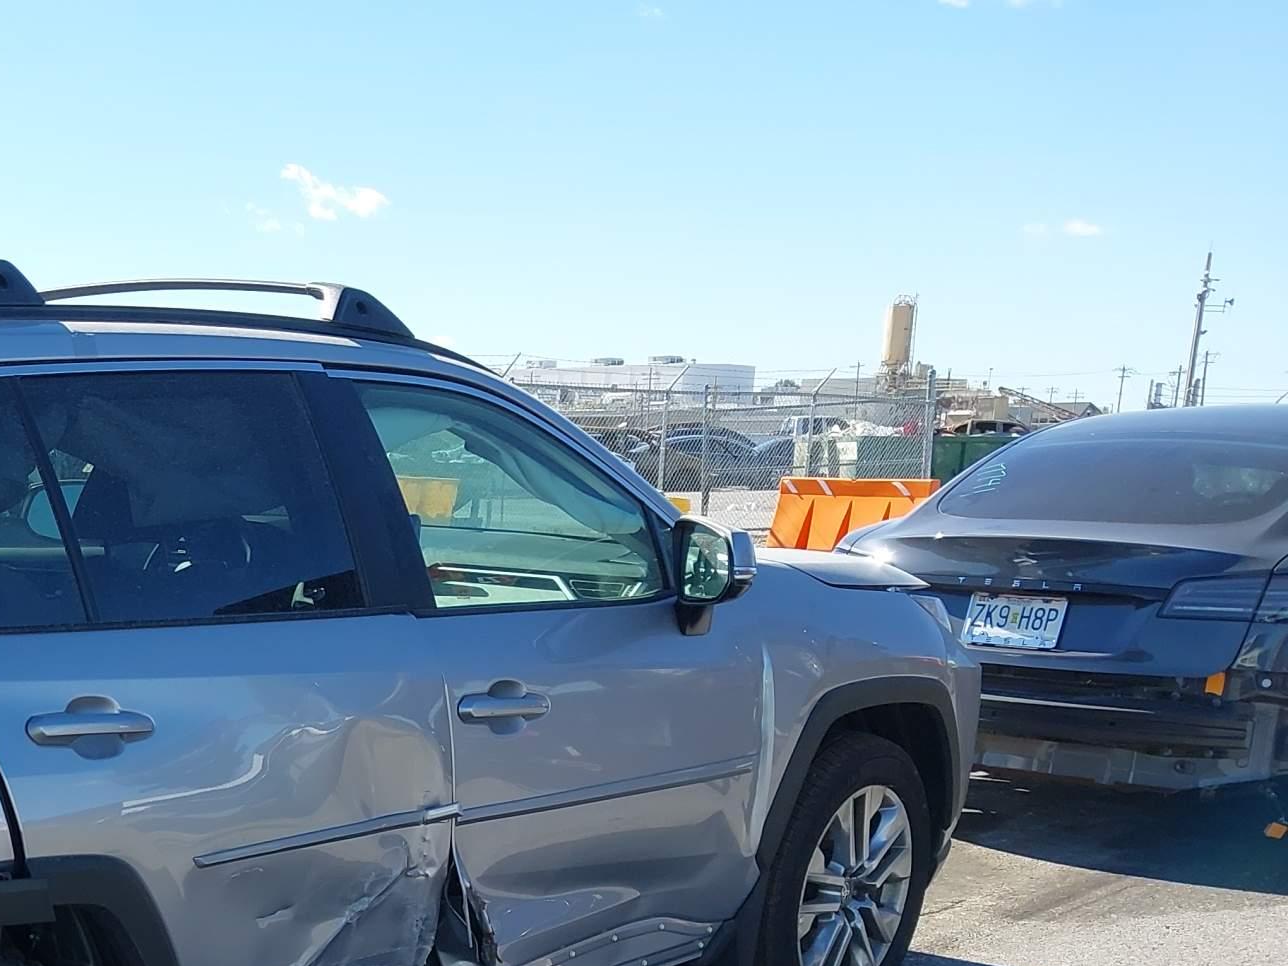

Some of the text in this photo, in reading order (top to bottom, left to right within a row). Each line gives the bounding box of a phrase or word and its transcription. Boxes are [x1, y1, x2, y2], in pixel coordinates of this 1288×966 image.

[958, 576, 1082, 591] TESLA
[971, 603, 1011, 628] ZK9
[1017, 606, 1059, 632] H8P
